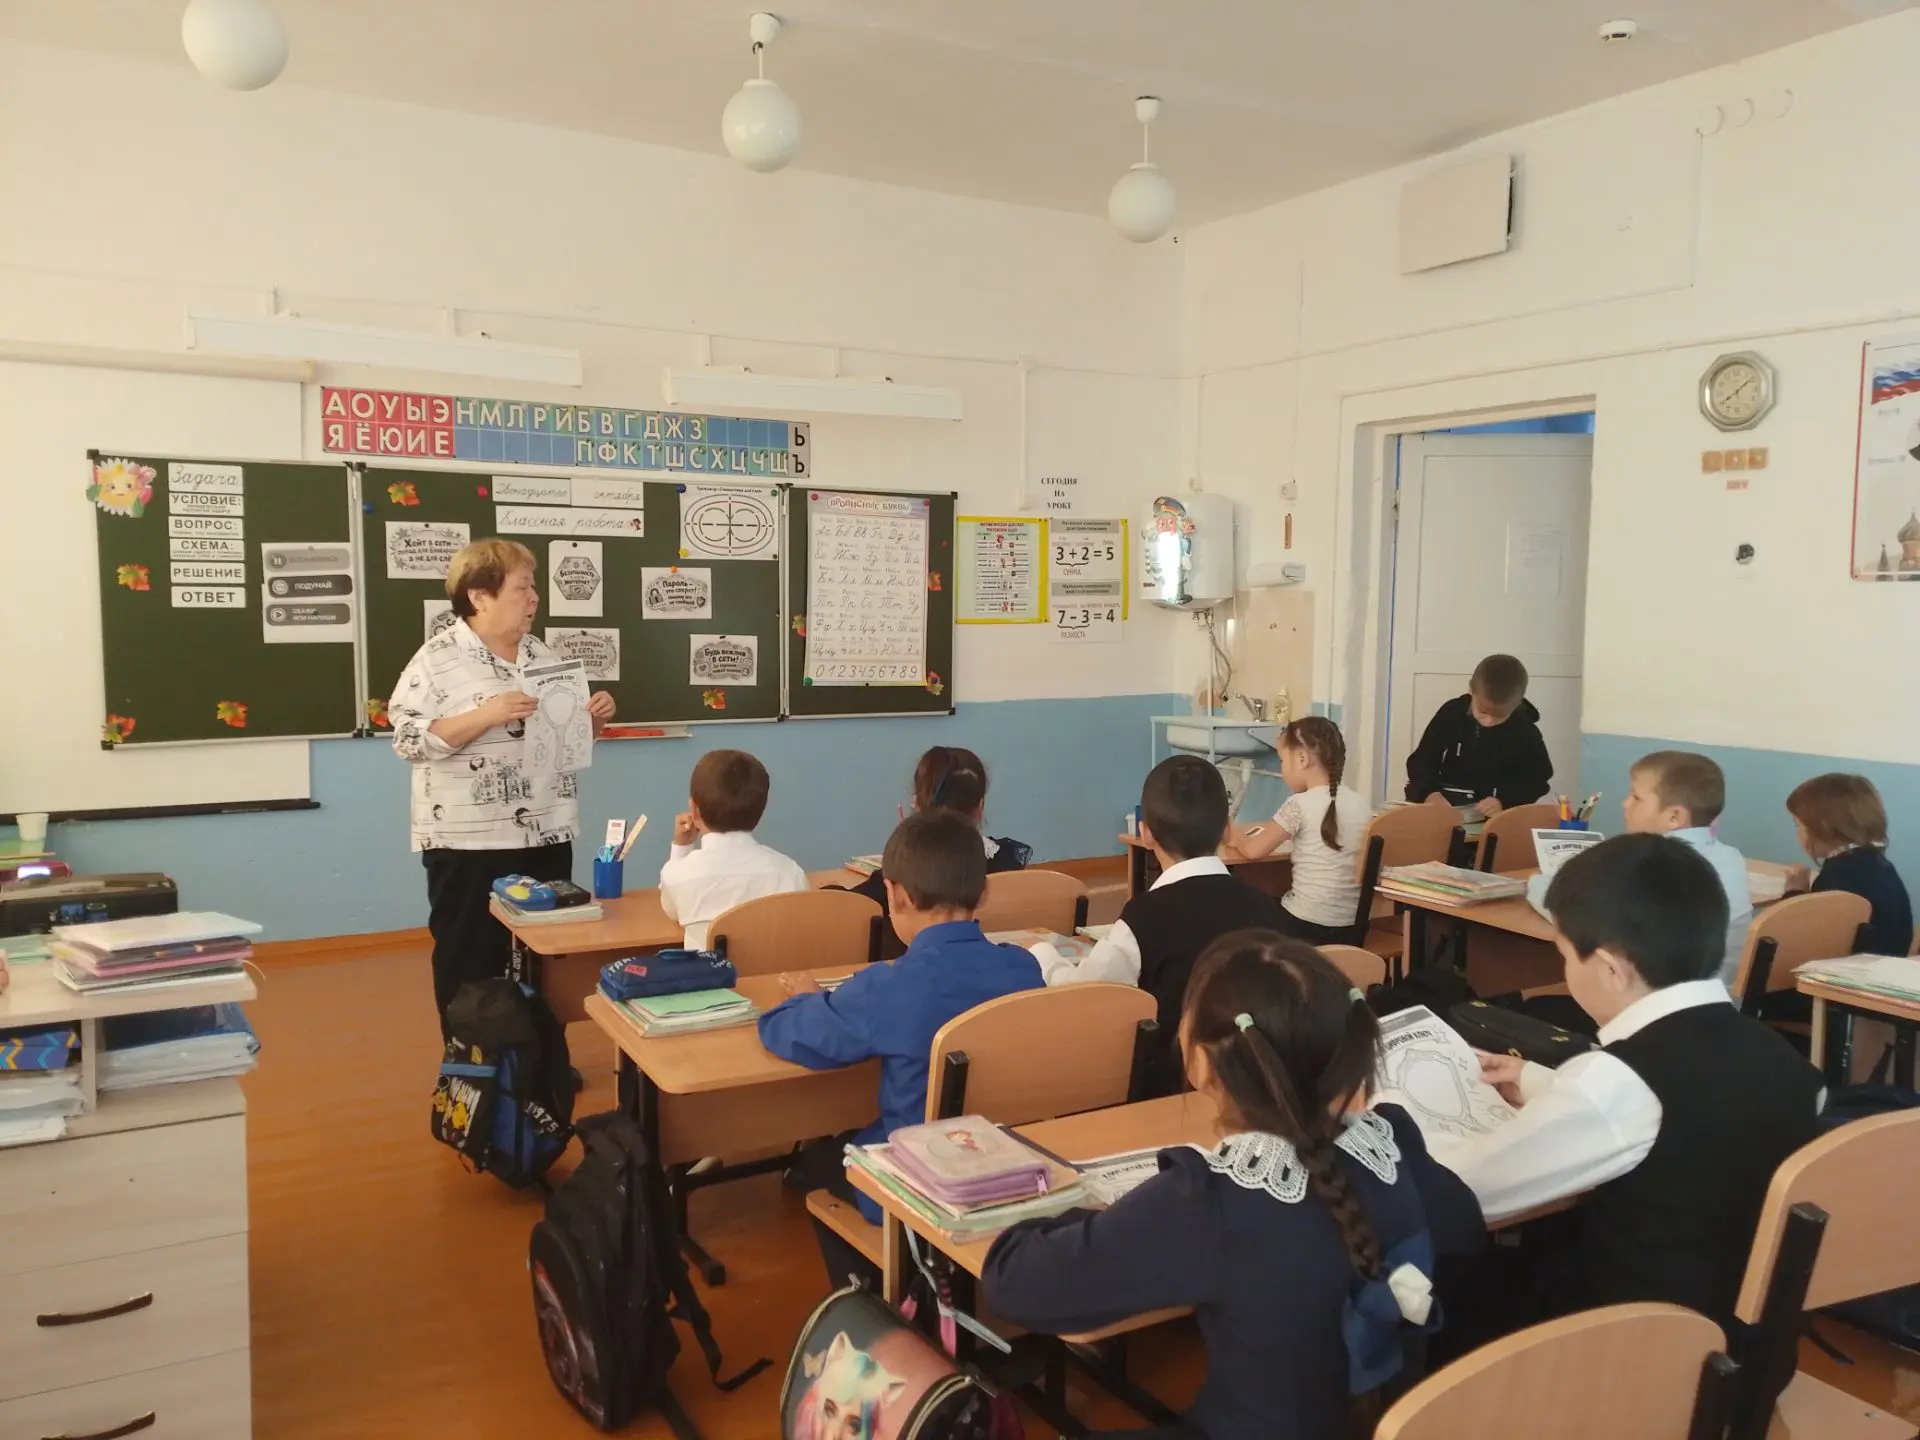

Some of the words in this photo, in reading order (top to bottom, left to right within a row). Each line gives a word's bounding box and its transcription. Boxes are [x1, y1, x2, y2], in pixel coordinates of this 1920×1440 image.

[171, 465, 238, 490] Задача
[1041, 477, 1078, 485] СЕГОДНЯ
[1054, 489, 1065, 497] НА
[172, 494, 241, 506] УСЛОВИЕ:
[1047, 502, 1072, 510] УРОКЕ
[500, 509, 566, 527] Классная
[174, 519, 237, 530] ВОПРОС:
[181, 540, 234, 550] СХЕМА:
[1056, 546, 1064, 561] 3
[1081, 546, 1089, 561] 2
[1106, 546, 1114, 561] 5
[173, 568, 242, 578] РЕШЕНИЕ
[294, 581, 333, 590] ПОДУМАЙ
[181, 591, 236, 603] ОТВЕТ
[1058, 610, 1066, 624] 7
[1081, 609, 1089, 624] 3
[1106, 609, 1115, 623] 4
